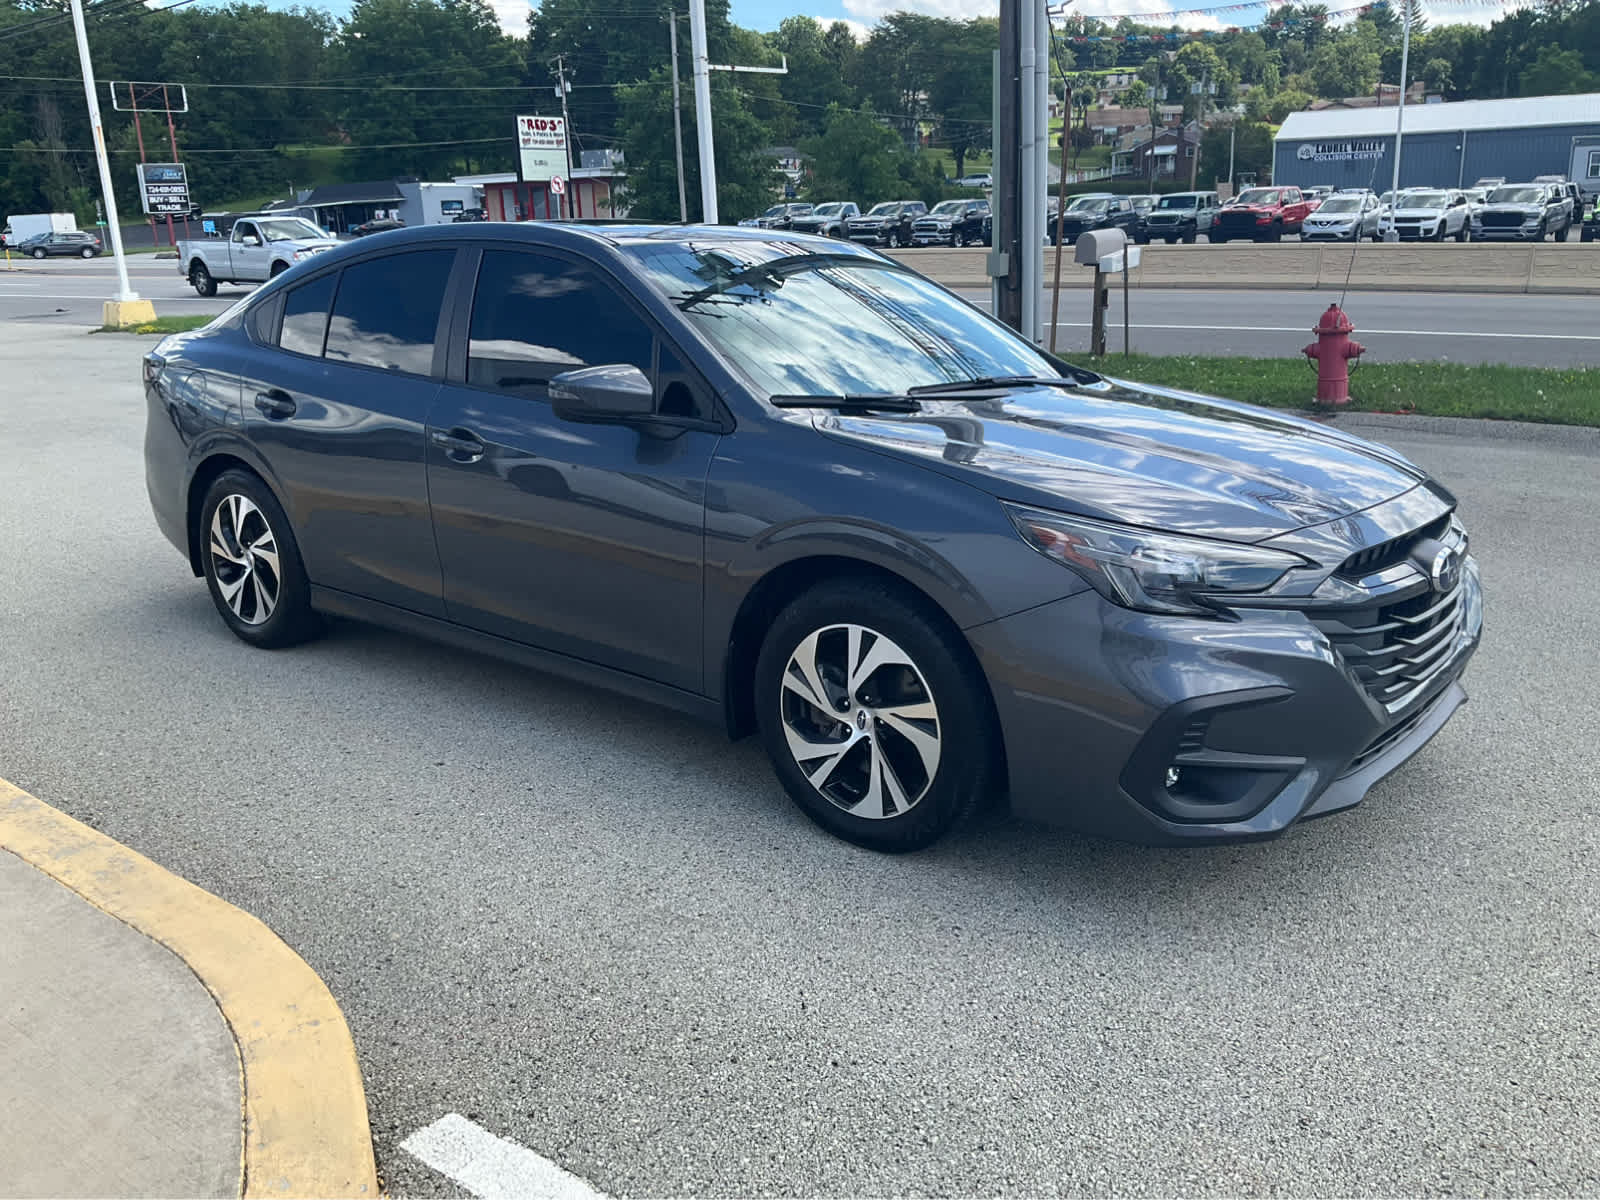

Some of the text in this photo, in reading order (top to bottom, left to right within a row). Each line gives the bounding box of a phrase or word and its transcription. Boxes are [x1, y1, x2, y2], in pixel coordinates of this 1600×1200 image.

[526, 118, 557, 131] RED'S
[1316, 141, 1384, 153] LAUREL VALLEY
